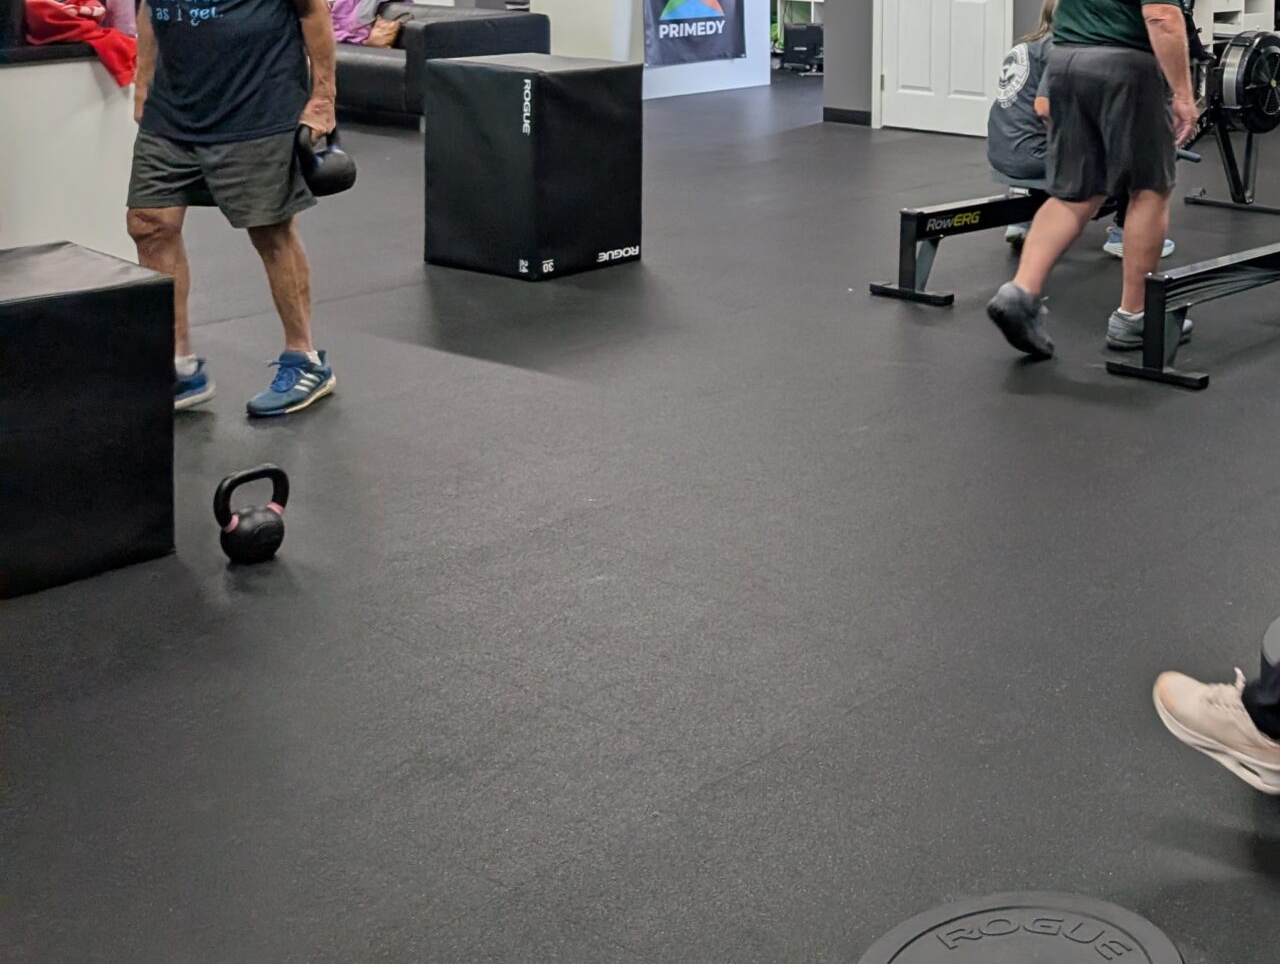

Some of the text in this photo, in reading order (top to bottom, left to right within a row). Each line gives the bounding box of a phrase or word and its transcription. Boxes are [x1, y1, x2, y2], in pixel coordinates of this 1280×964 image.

[155, 7, 171, 22] as
[658, 20, 726, 39] PRIMEDY
[522, 78, 532, 135] ROGUE
[597, 244, 641, 263] ROGUE
[543, 262, 554, 274] 30
[936, 918, 1134, 961] ROGUE
